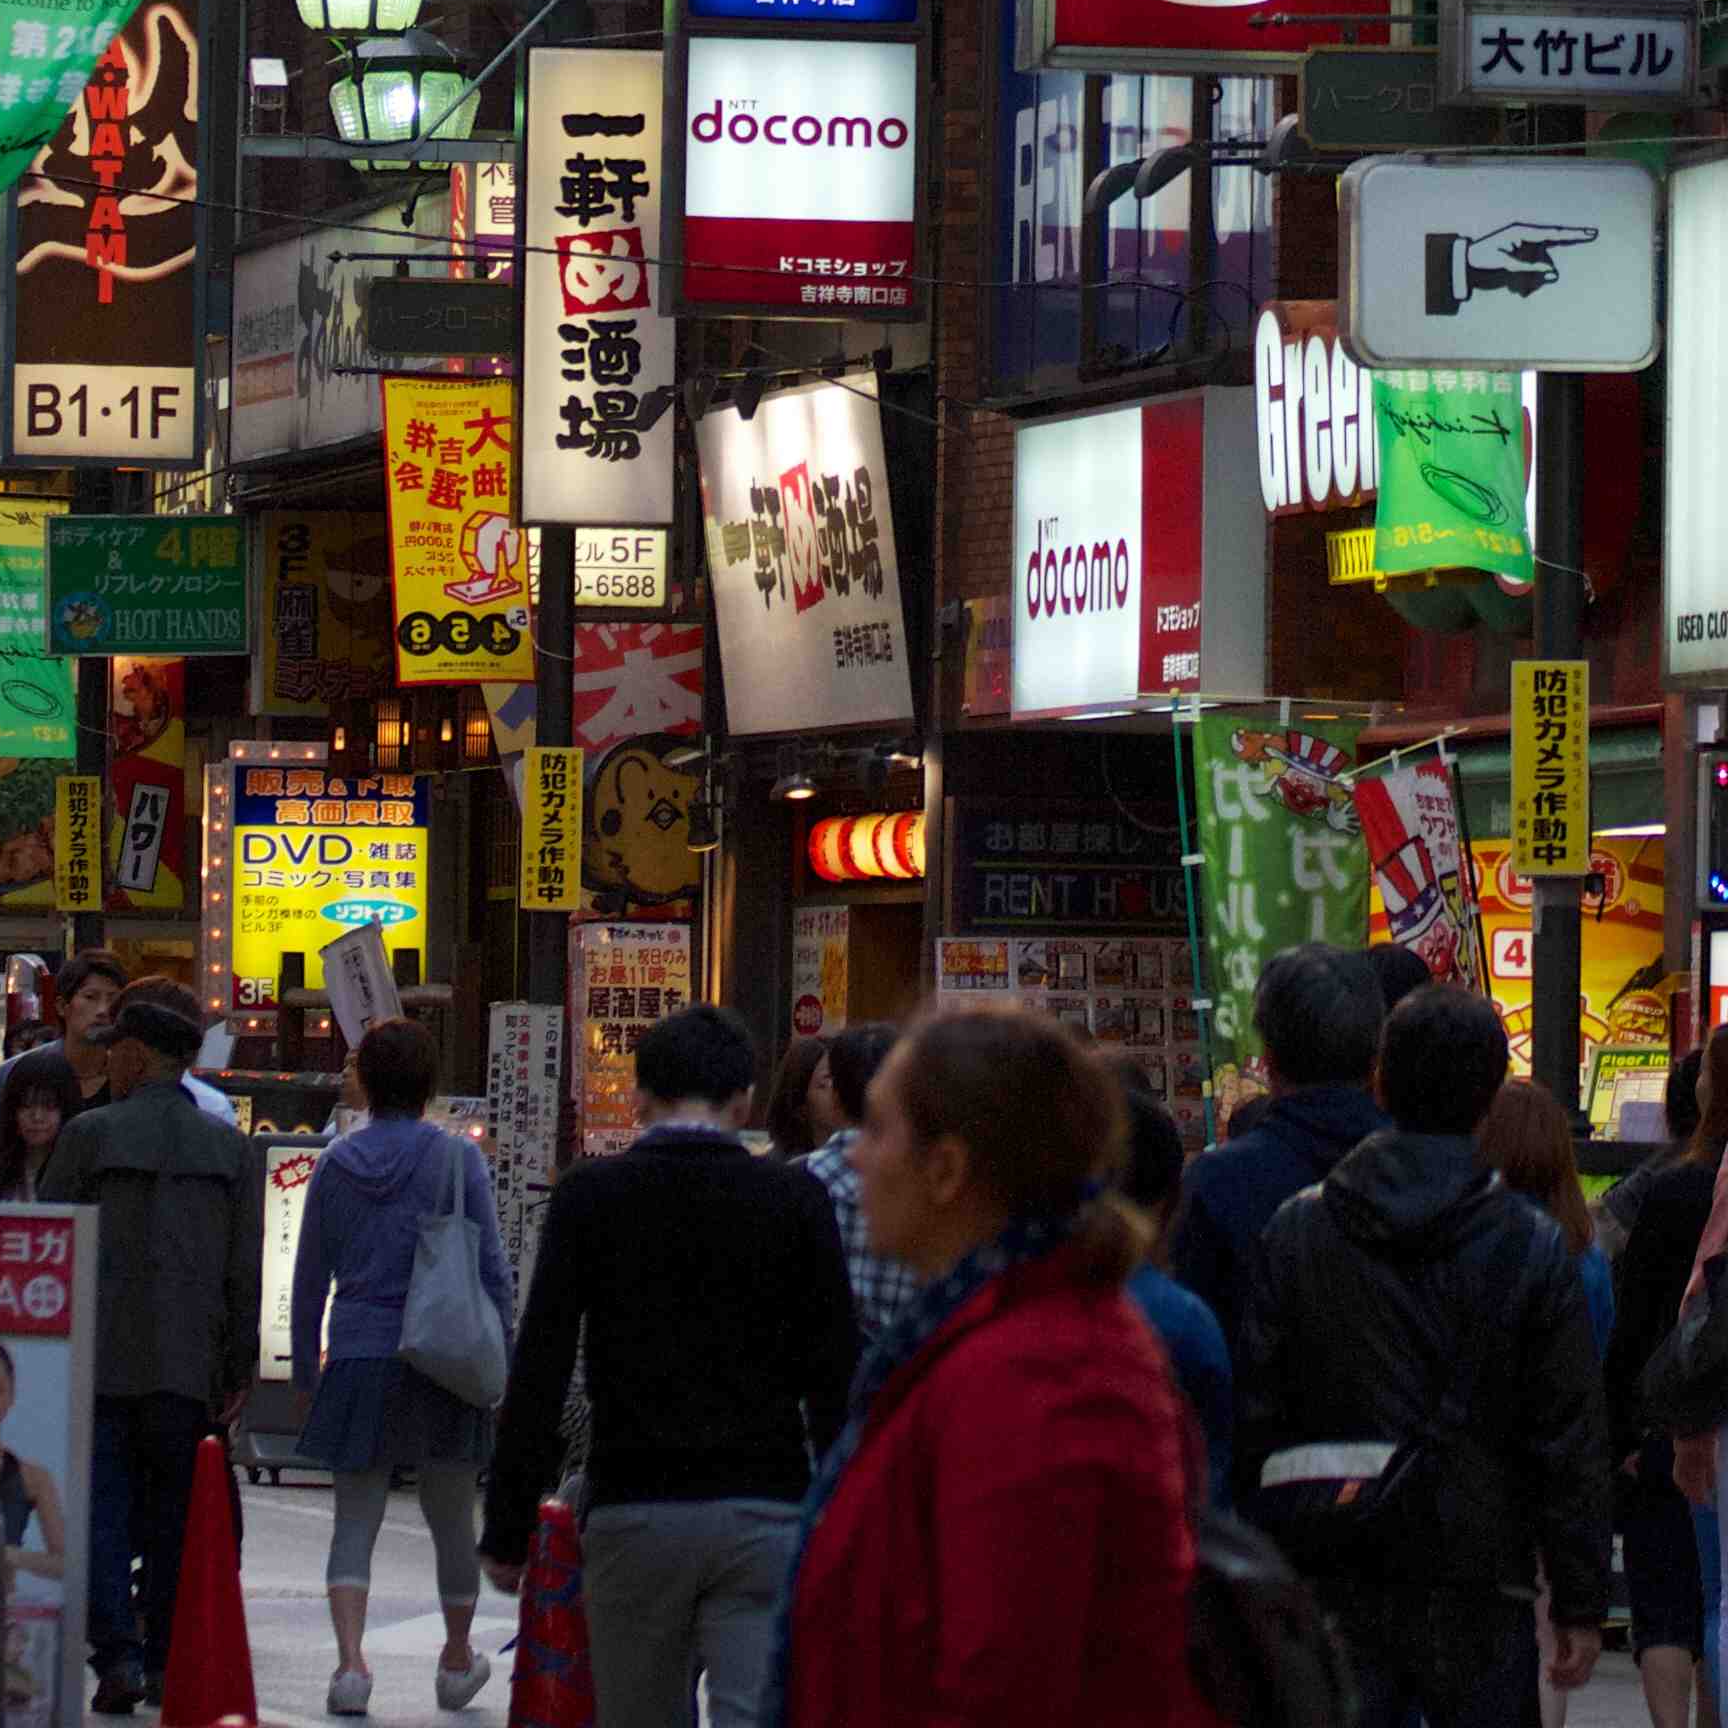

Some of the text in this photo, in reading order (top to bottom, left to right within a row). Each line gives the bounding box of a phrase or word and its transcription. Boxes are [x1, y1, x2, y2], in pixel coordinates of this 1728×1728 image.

[1480, 27, 1674, 77] 大竹ビル
[728, 99, 760, 111] NTT
[690, 98, 910, 151] docomo
[778, 255, 908, 279] ドコモショップ
[554, 112, 652, 463] 一軒め酒場
[799, 283, 908, 307] 吉祥寺南口店
[51, 527, 147, 547] ボディケア
[154, 526, 242, 570] 4階
[1026, 517, 1130, 620] docomo
[92, 575, 241, 595] リフレクソロジー
[114, 607, 242, 643] HOT HANDS
[1156, 601, 1201, 634] ドコモショップ
[1676, 611, 1705, 643] USED
[245, 770, 416, 797] 販売&下取
[1530, 668, 1569, 868] 防犯カメラ作動中
[275, 798, 415, 826] 高価買取
[537, 750, 569, 905] 防犯カメラ作動中
[67, 783, 89, 905] 防犯カメラ作動中
[241, 833, 354, 866] DVD
[241, 869, 417, 889] コミック・写真集
[240, 907, 318, 922] レンガ模様の
[334, 902, 405, 924] ソフトイン
[238, 975, 274, 1007] 3F
